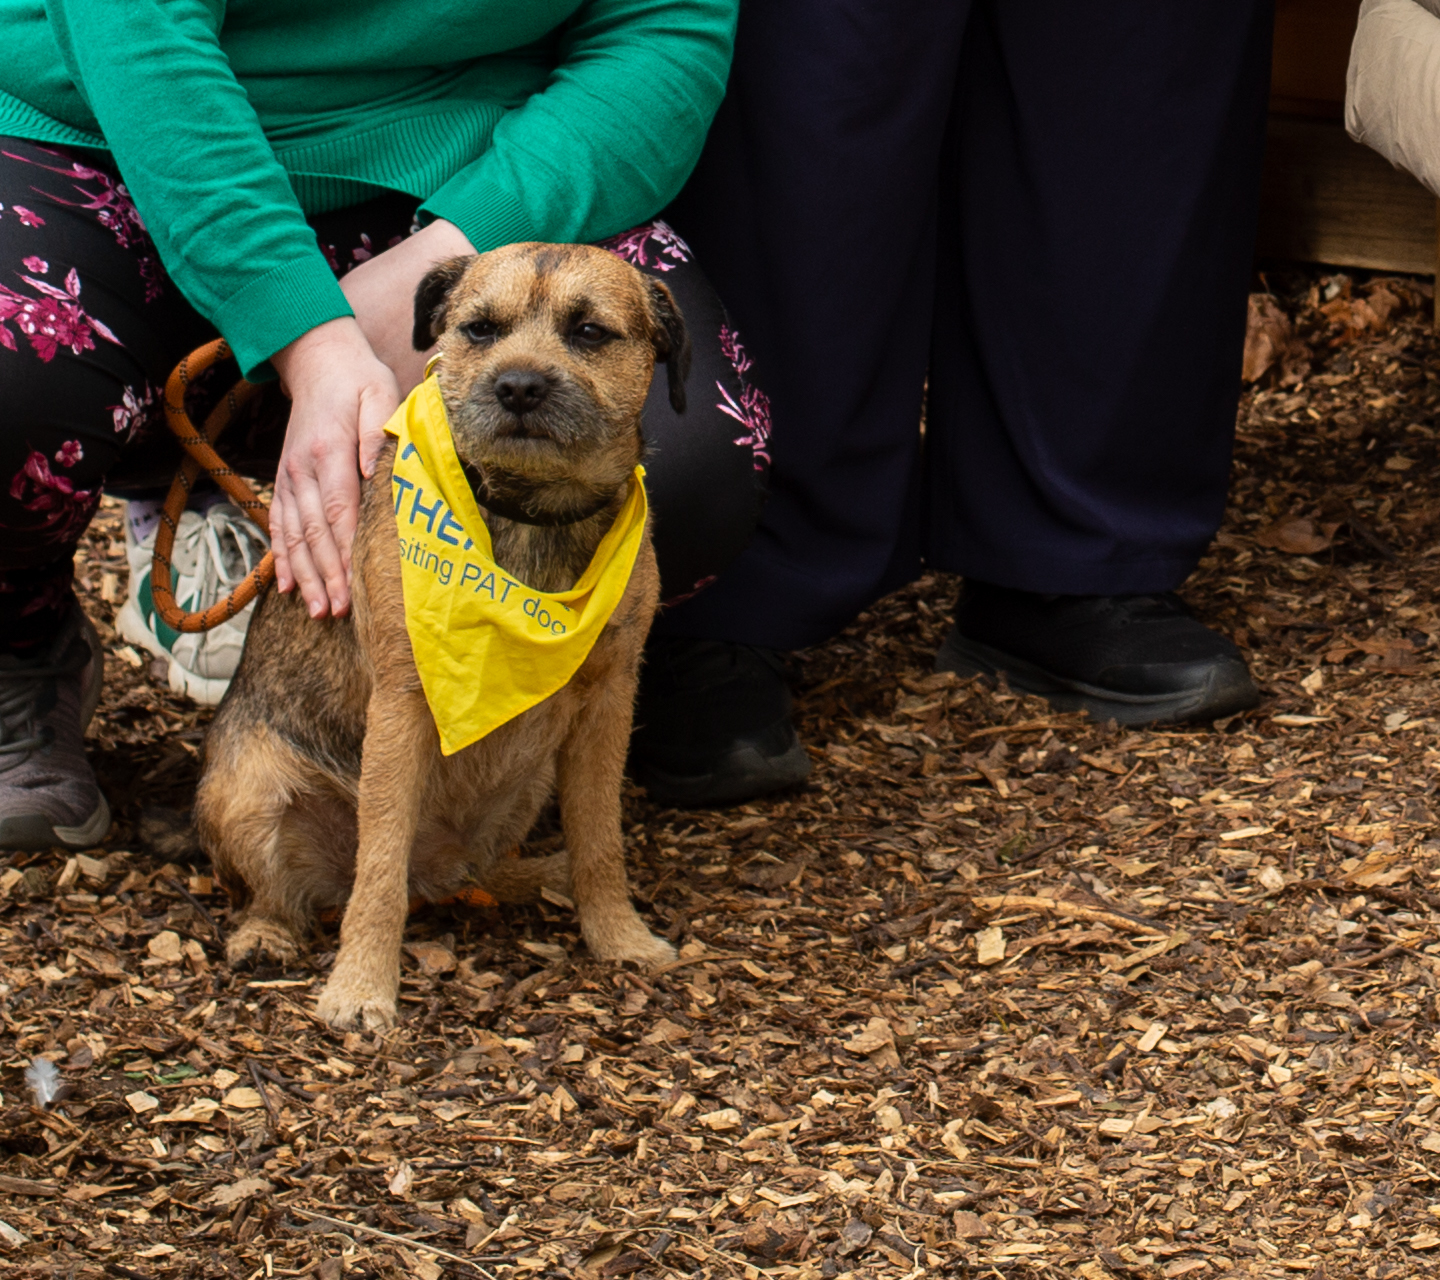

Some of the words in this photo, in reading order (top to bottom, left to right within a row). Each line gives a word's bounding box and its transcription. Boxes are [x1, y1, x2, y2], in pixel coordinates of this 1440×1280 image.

[392, 474, 474, 550] THE
[460, 563, 520, 604] PAT
[523, 597, 566, 636] dog
